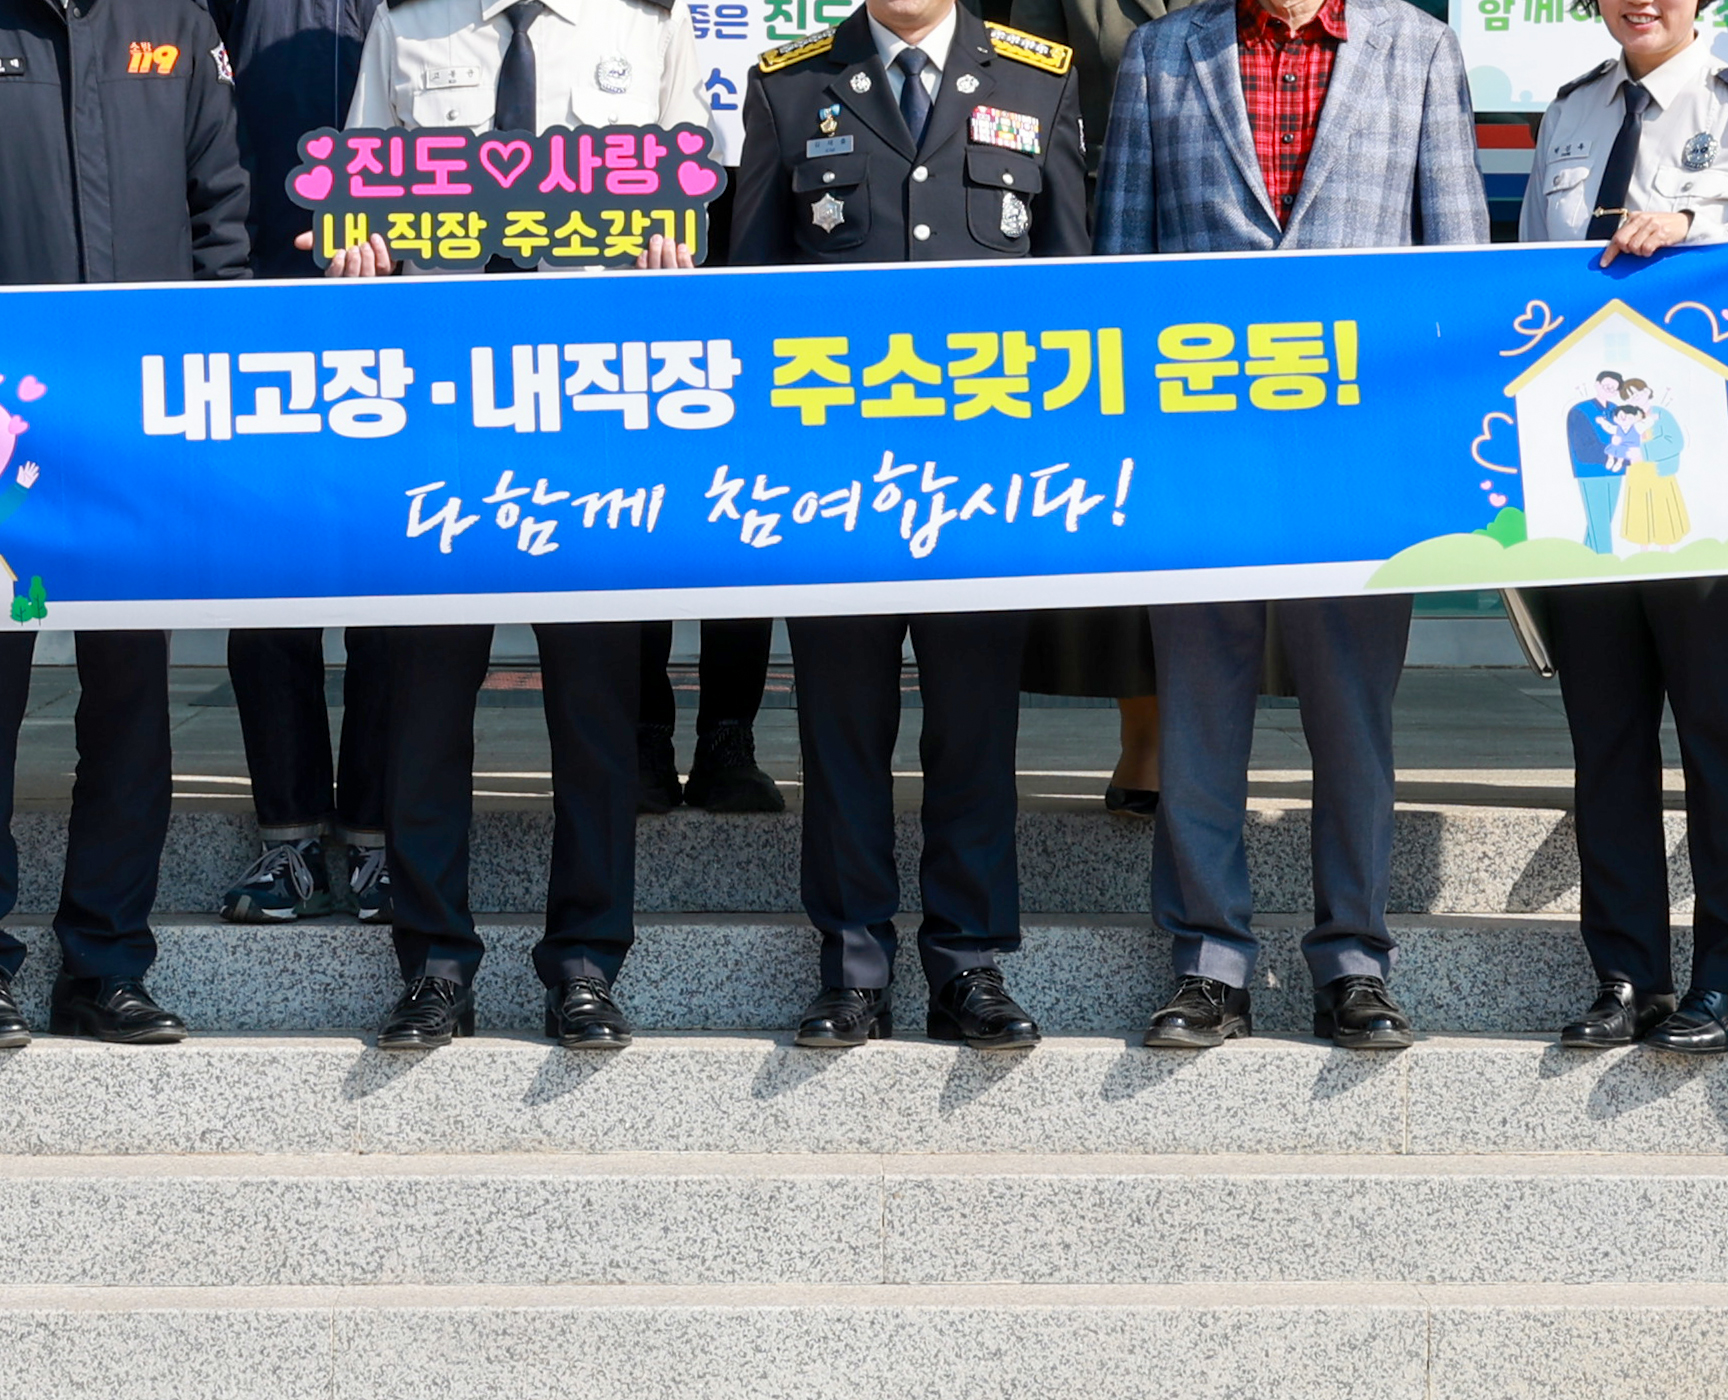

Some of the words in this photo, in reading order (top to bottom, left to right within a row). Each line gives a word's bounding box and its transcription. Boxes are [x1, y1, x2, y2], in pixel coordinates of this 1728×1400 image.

[127, 44, 181, 75] 119
[502, 208, 697, 257] 주소갖기
[770, 326, 1125, 426] 주소갖기
[1154, 318, 1360, 415] 운동!
[404, 465, 665, 556] 다함께
[704, 450, 1135, 559] 참여합시다!
